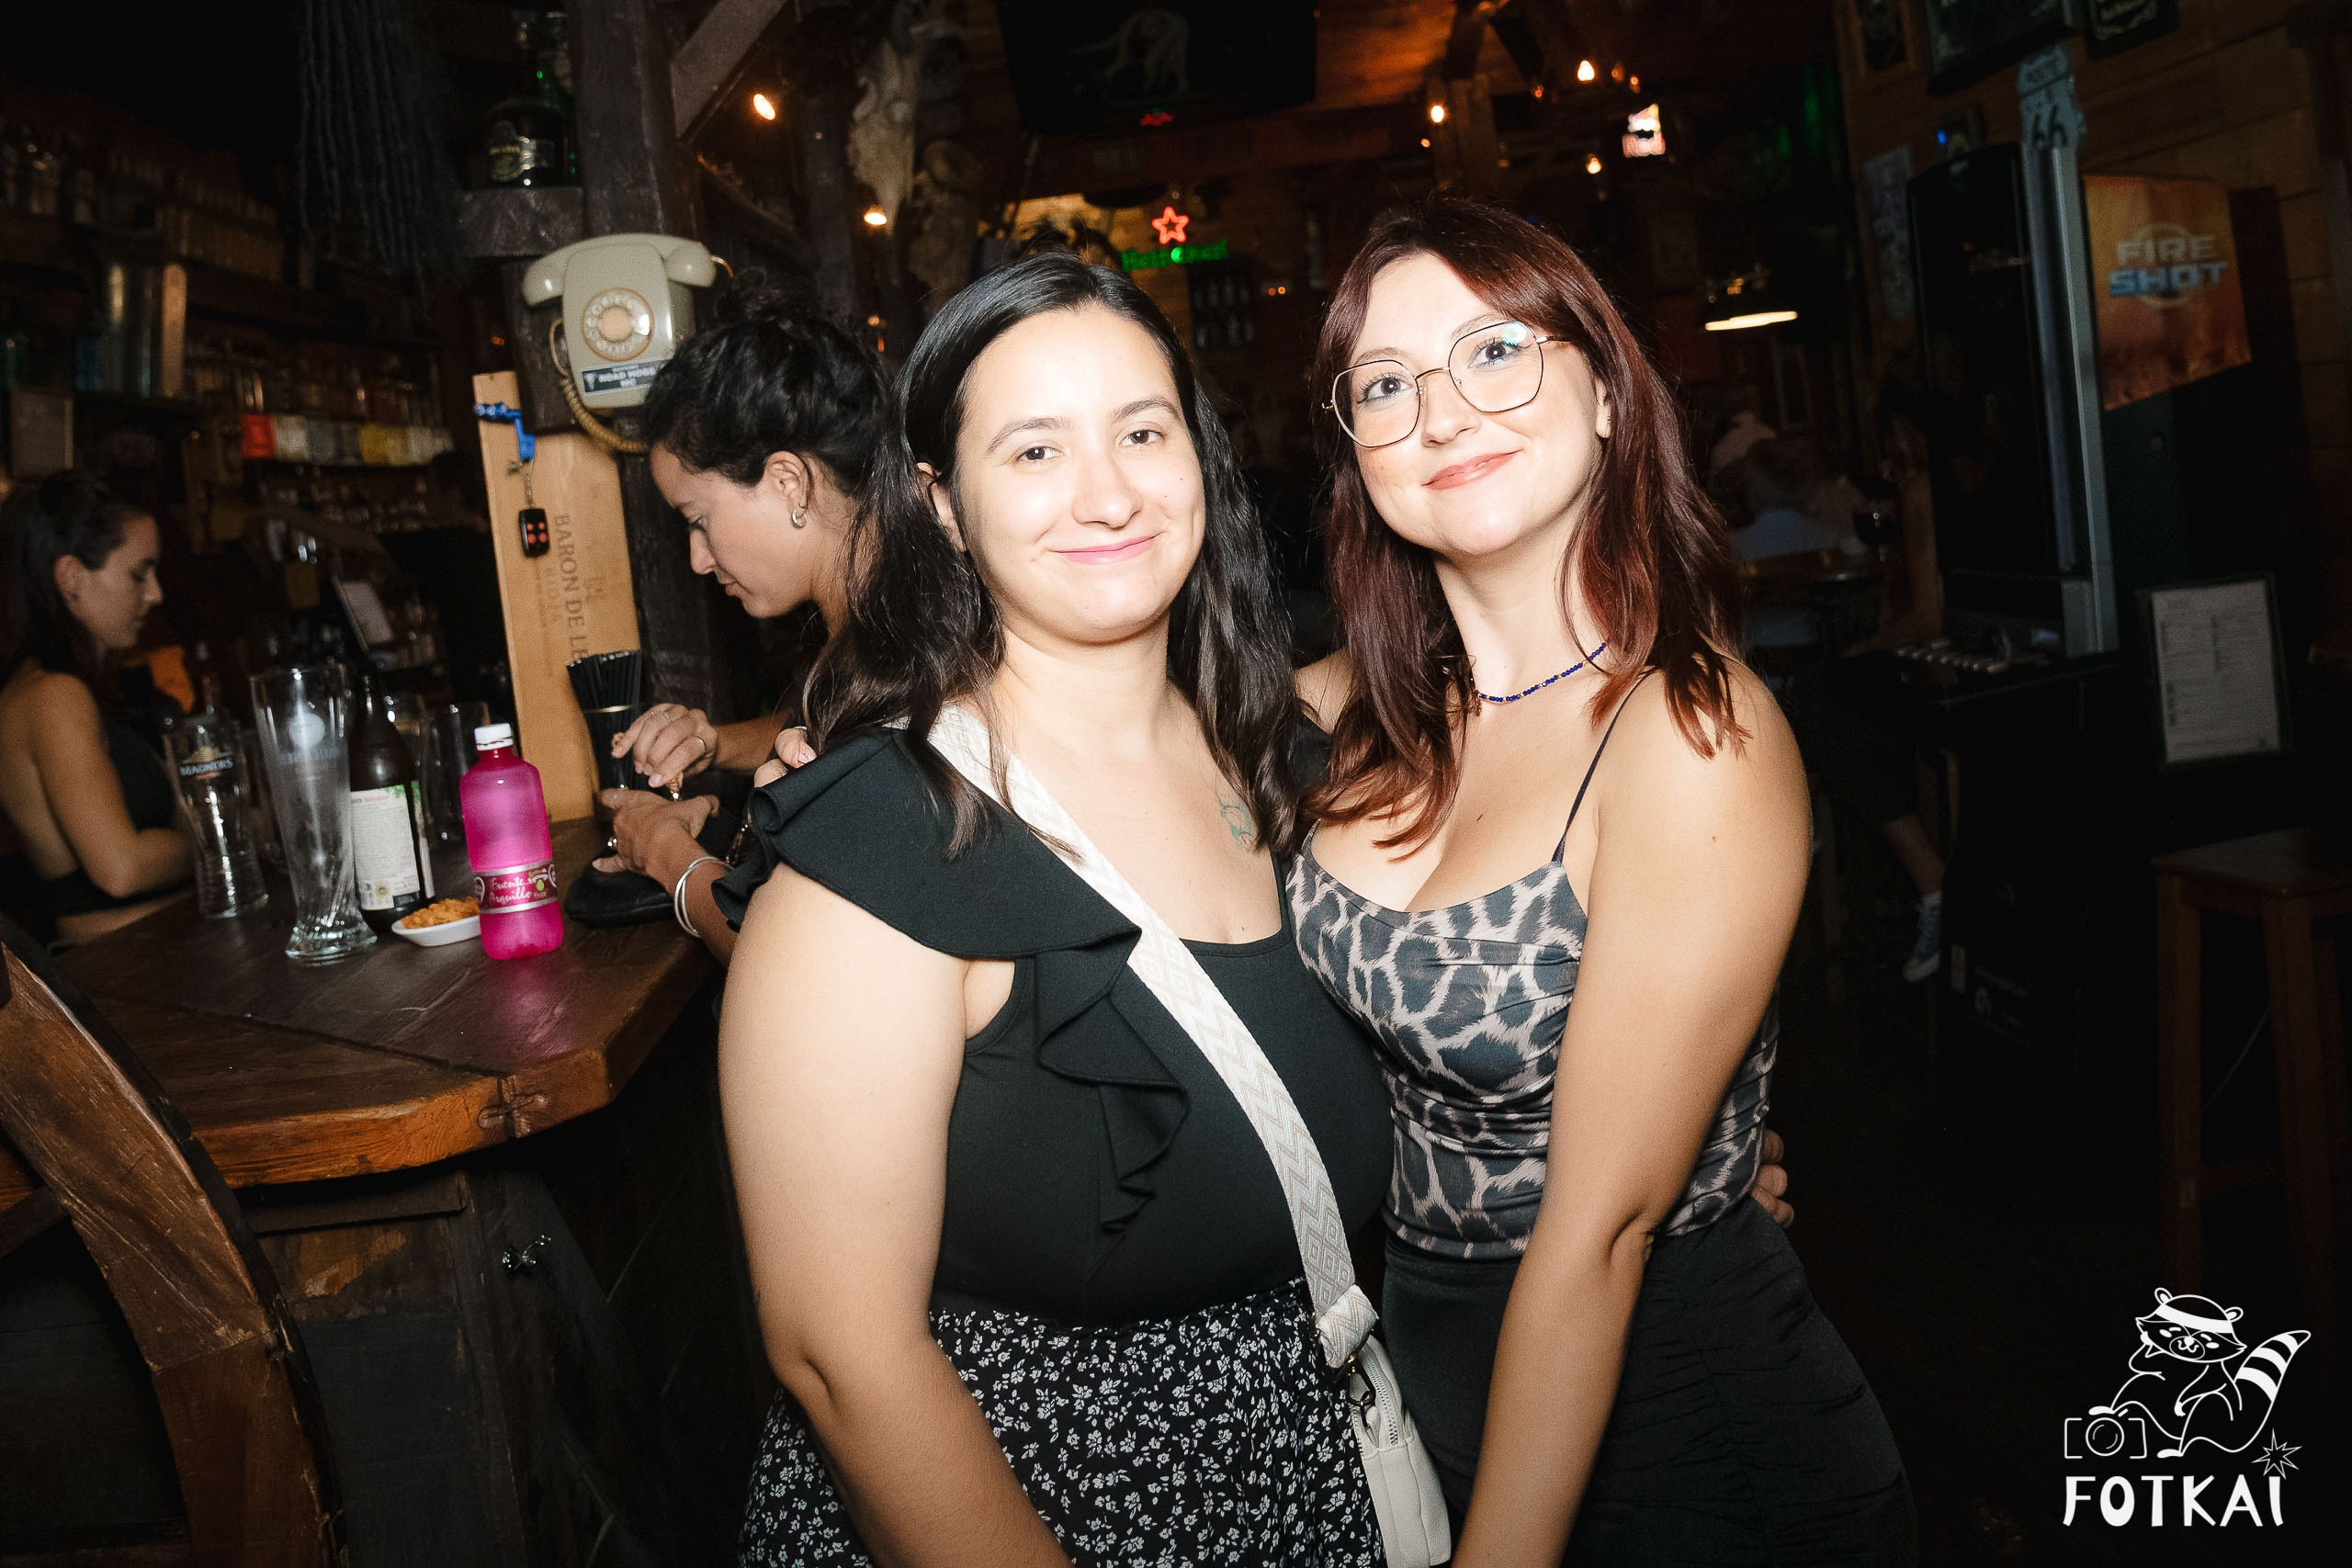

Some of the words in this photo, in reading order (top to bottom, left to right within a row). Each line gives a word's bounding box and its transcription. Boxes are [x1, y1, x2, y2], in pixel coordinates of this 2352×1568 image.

[2117, 234, 2216, 265] FIRE
[2108, 260, 2230, 297] SHOT
[555, 513, 579, 592] BARON
[565, 599, 586, 629] DE
[570, 635, 590, 660] LE
